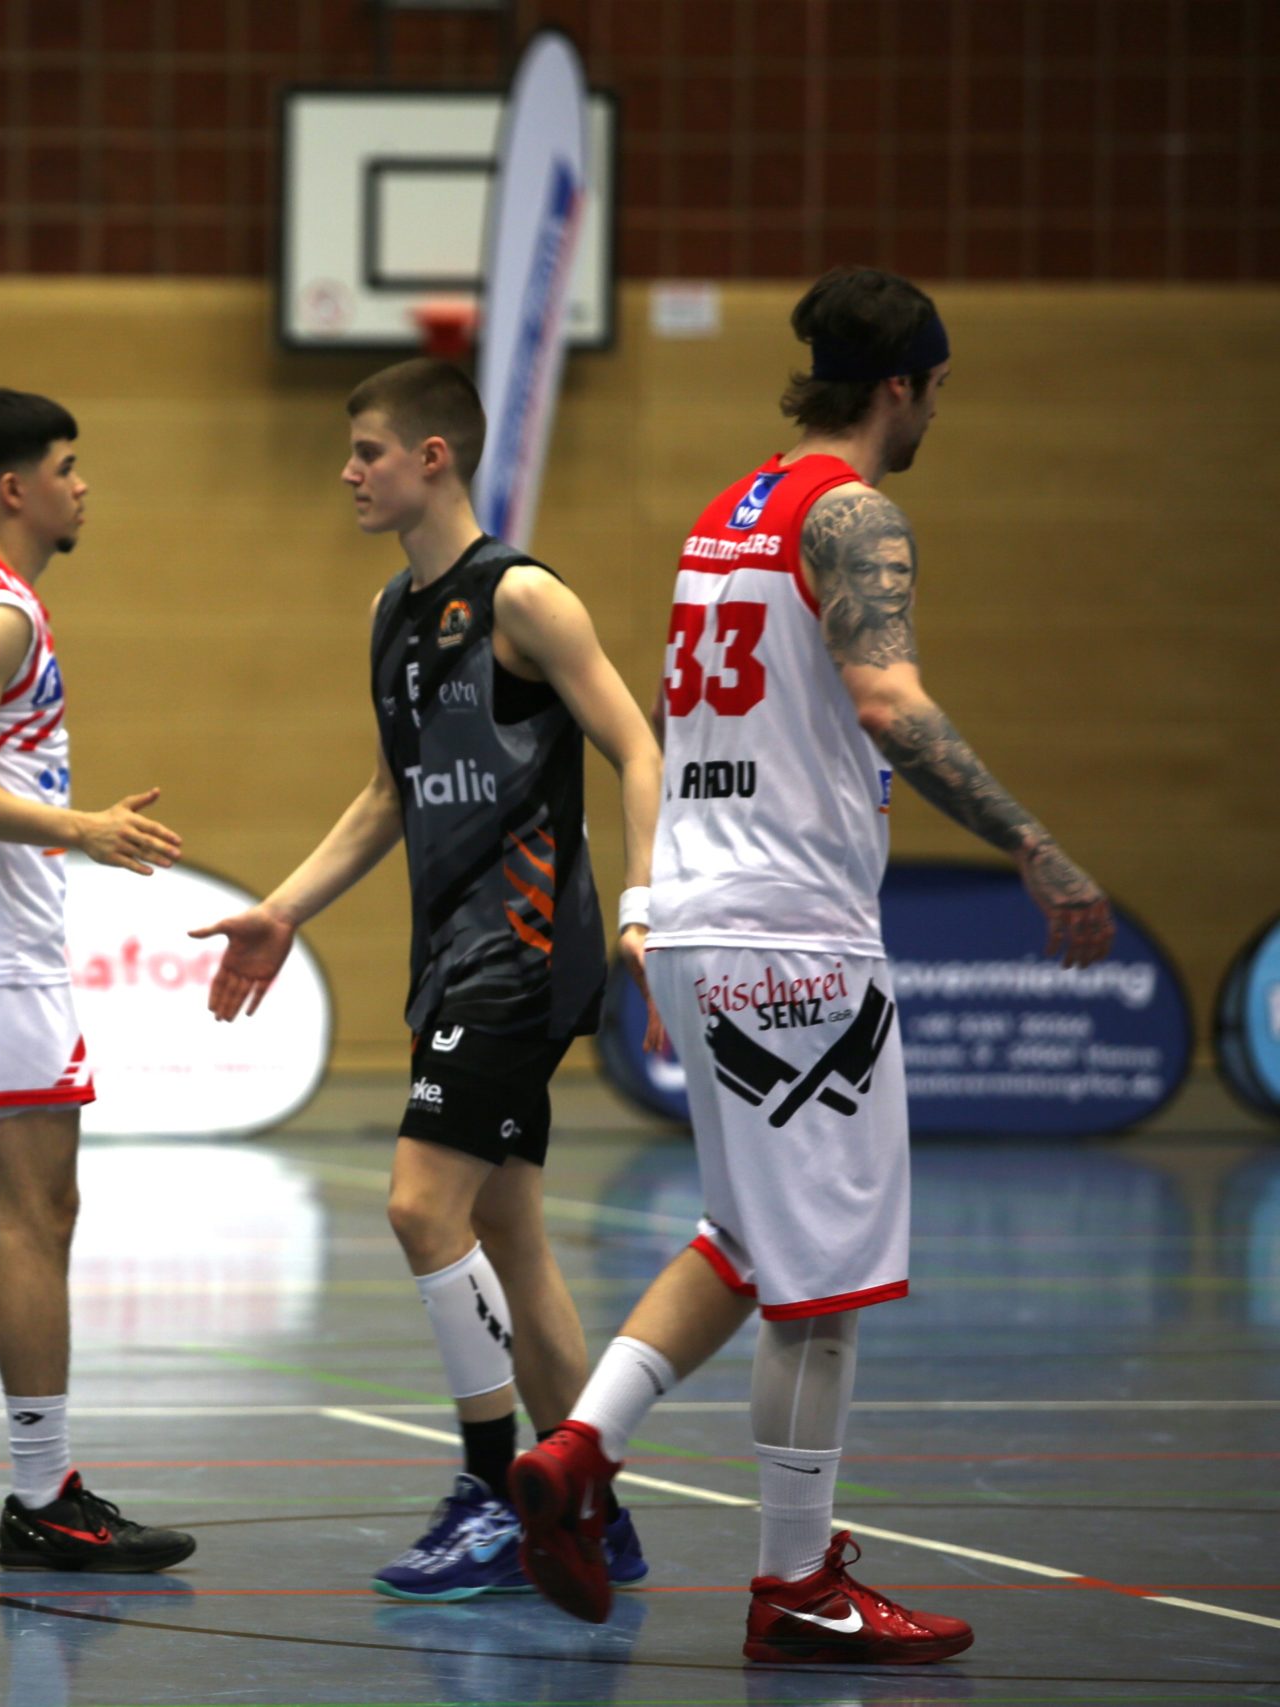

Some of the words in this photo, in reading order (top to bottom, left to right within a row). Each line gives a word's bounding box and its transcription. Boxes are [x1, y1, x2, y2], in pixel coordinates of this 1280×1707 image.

[664, 600, 767, 717] 33
[405, 759, 498, 808] Talia
[757, 998, 824, 1031] SENZ
